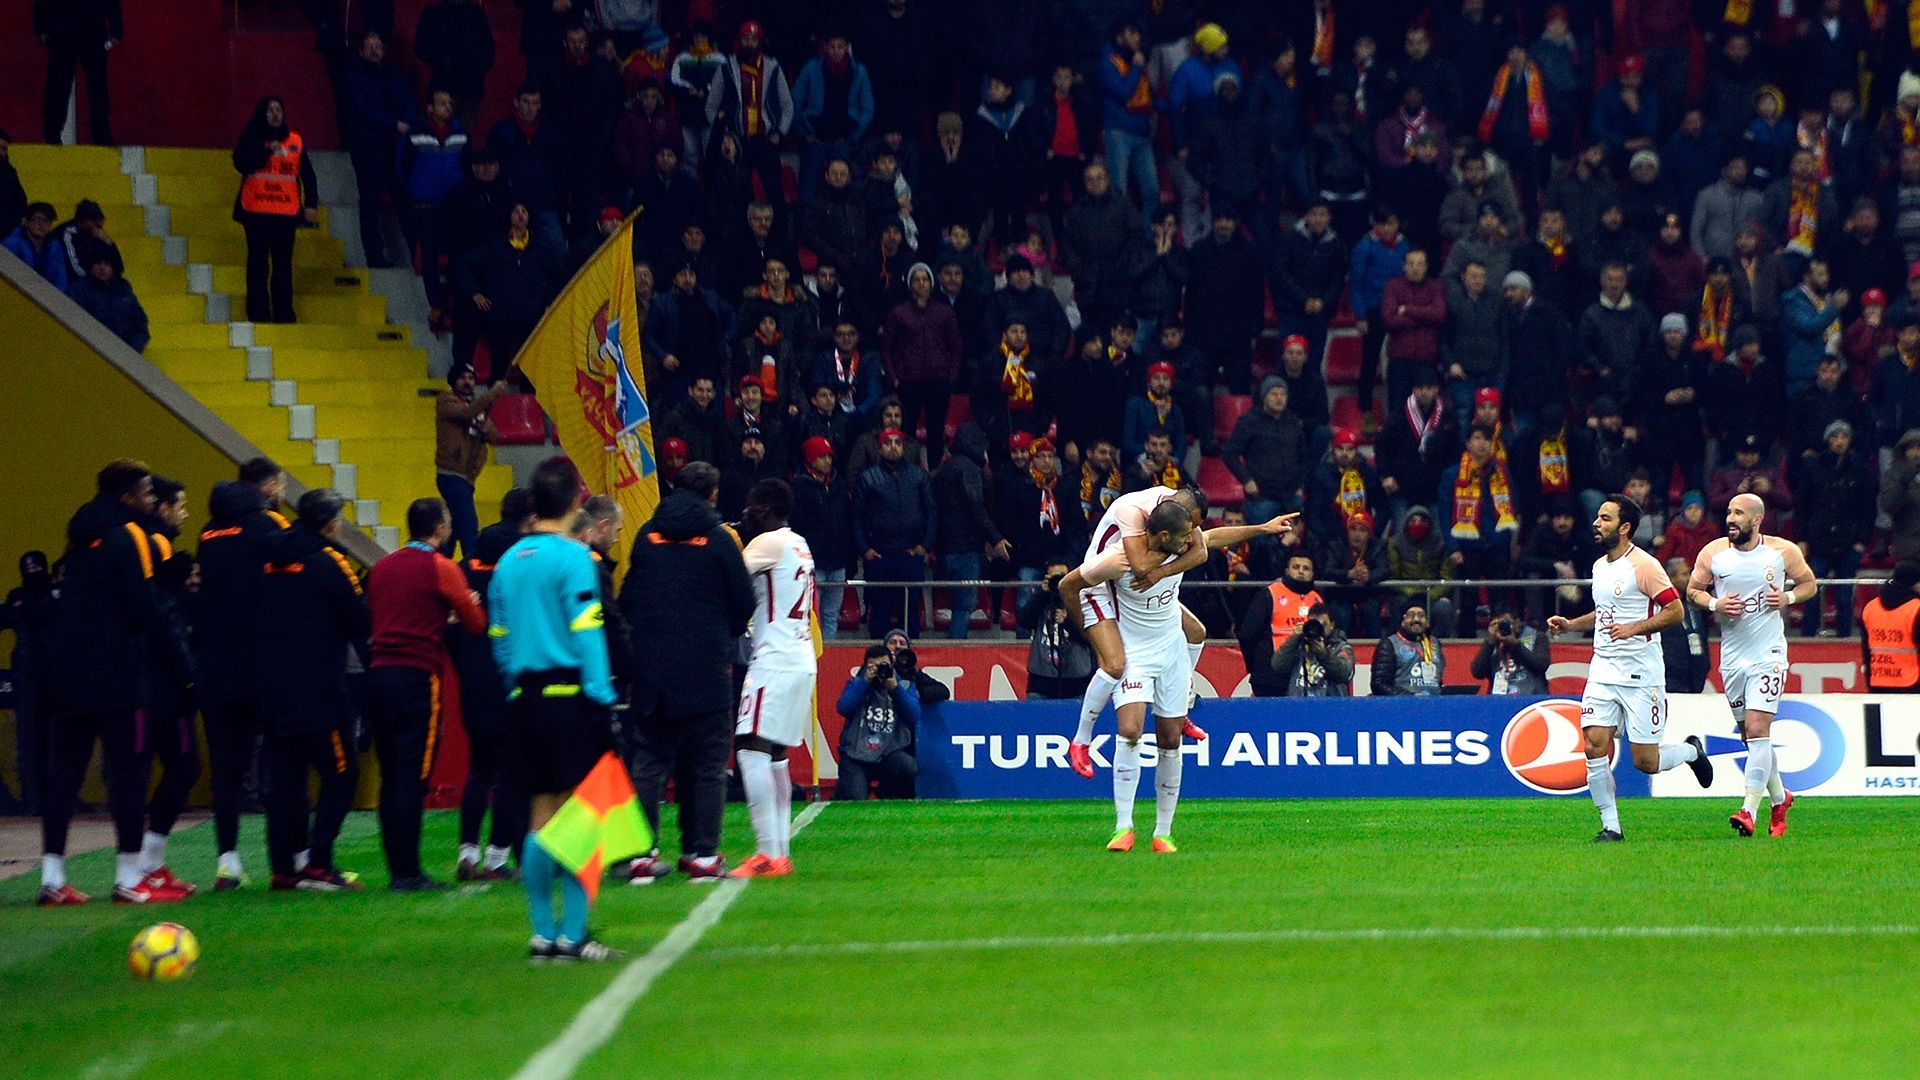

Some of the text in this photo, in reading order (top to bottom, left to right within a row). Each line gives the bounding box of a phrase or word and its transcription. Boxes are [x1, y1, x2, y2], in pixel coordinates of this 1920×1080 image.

[1744, 591, 1764, 613] ef
[1759, 675, 1780, 696] 33
[1651, 705, 1660, 725] 8
[1863, 703, 1920, 767] L
[951, 730, 1490, 769] TURKSH AIRLINES
[1865, 777, 1920, 788] HAST
